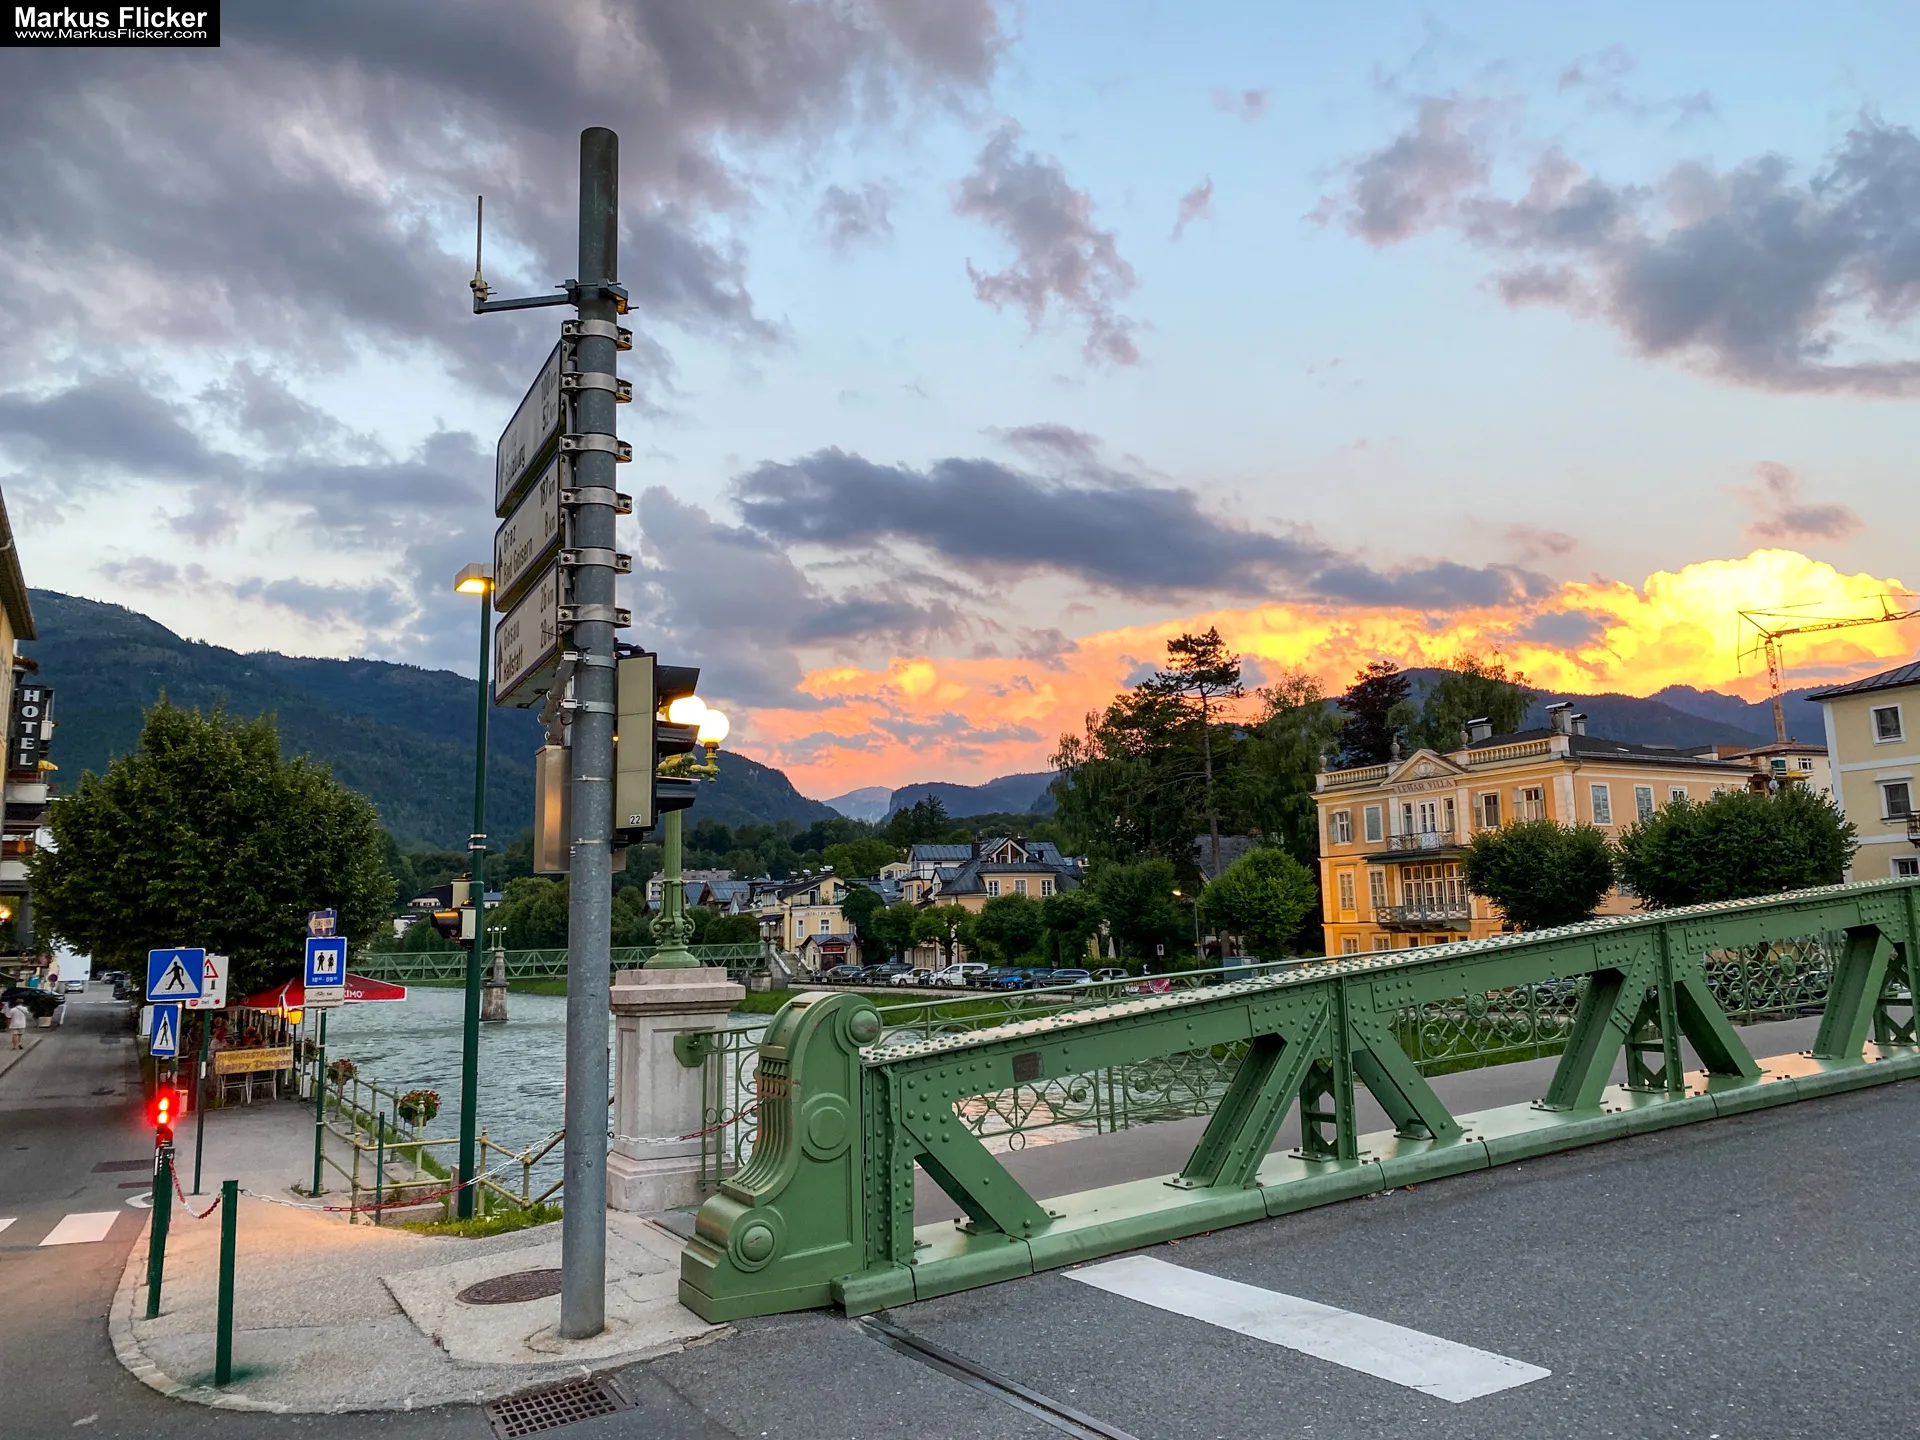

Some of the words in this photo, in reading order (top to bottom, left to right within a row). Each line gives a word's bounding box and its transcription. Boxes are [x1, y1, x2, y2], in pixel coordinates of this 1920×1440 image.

[504, 525, 516, 554] Graz
[20, 689, 40, 766] HOTEL
[630, 815, 641, 825] 22
